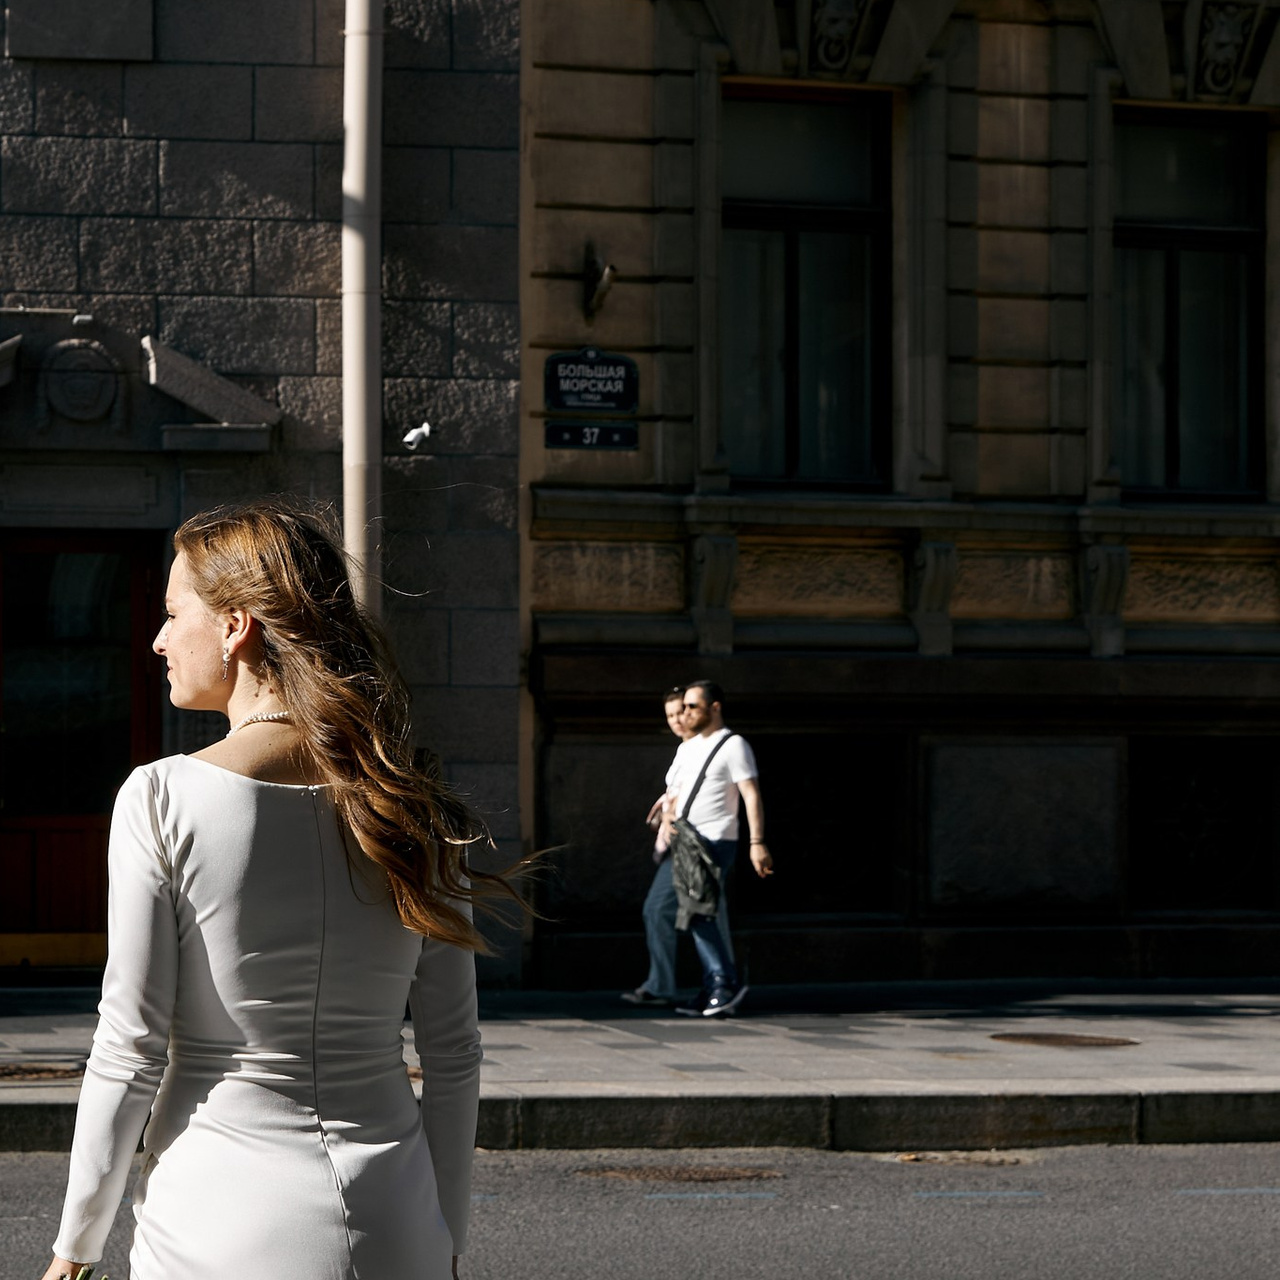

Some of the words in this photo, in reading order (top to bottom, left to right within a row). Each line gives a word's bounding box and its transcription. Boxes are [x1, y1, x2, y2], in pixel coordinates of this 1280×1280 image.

[557, 363, 627, 379] БОЛЬШАЯ
[559, 378, 625, 393] МОРСКАЯ
[582, 427, 601, 445] 37
